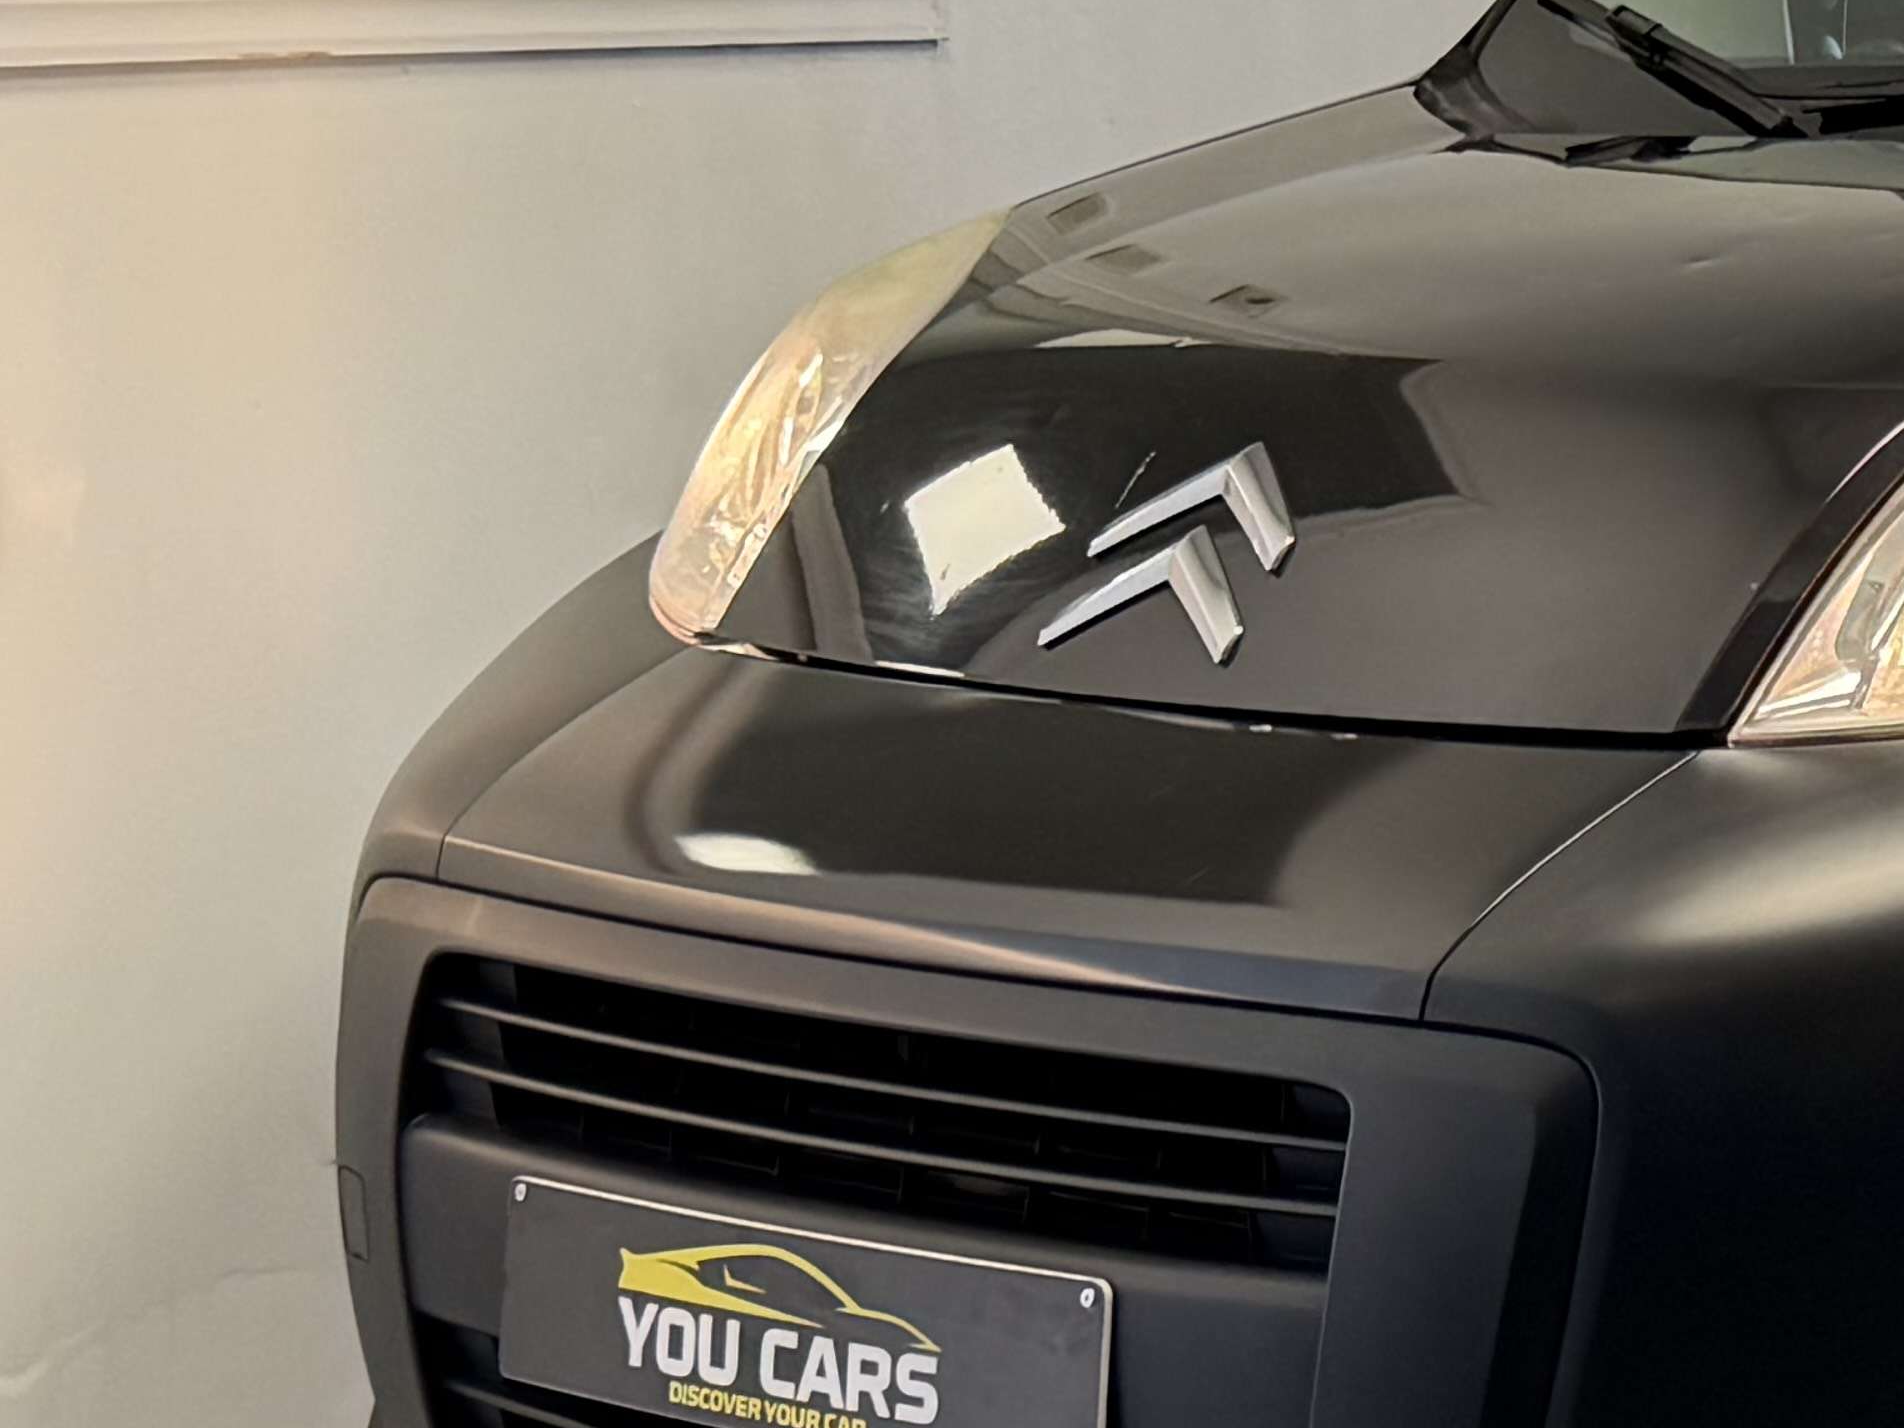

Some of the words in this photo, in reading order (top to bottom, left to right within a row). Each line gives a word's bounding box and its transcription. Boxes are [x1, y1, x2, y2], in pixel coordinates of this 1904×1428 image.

[618, 1296, 740, 1387] YOU
[760, 1327, 938, 1425] CARS
[669, 1380, 761, 1421] DISCOVER
